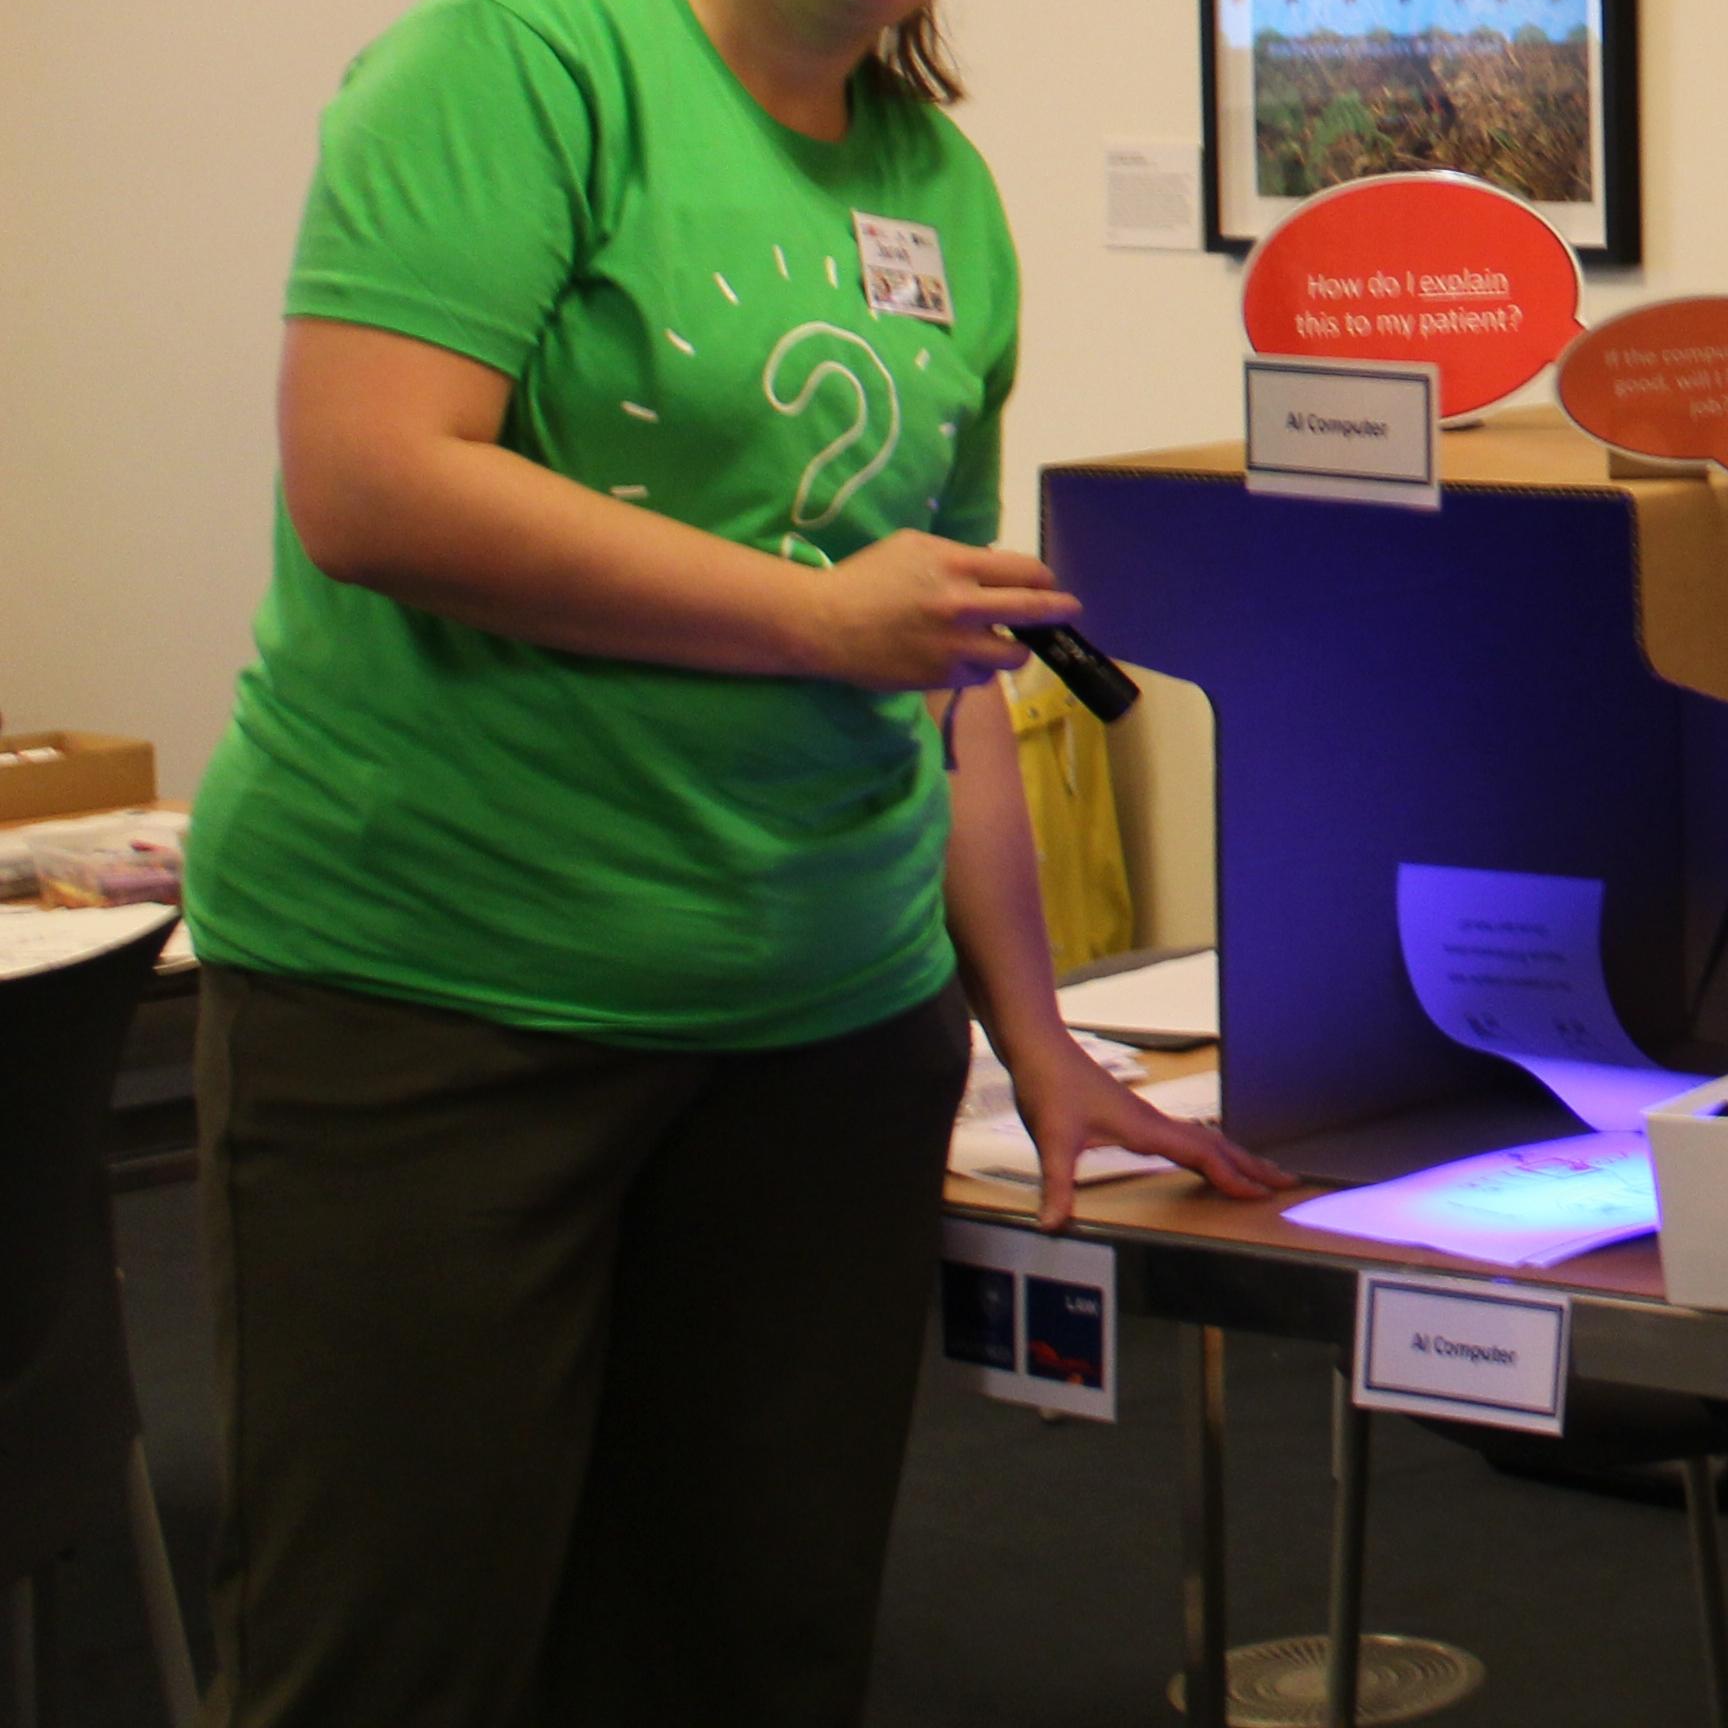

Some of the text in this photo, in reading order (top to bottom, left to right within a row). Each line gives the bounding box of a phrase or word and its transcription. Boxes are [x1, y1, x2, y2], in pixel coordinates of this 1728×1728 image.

[1307, 266, 1511, 301] How do I explain
[1295, 304, 1523, 341] this to my patient?
[1604, 347, 1619, 370] If
[1622, 347, 1658, 368] the
[1675, 369, 1711, 392] will
[1713, 370, 1722, 388] I
[1285, 411, 1389, 440] AI Computer
[1410, 1332, 1519, 1368] AI Computer
